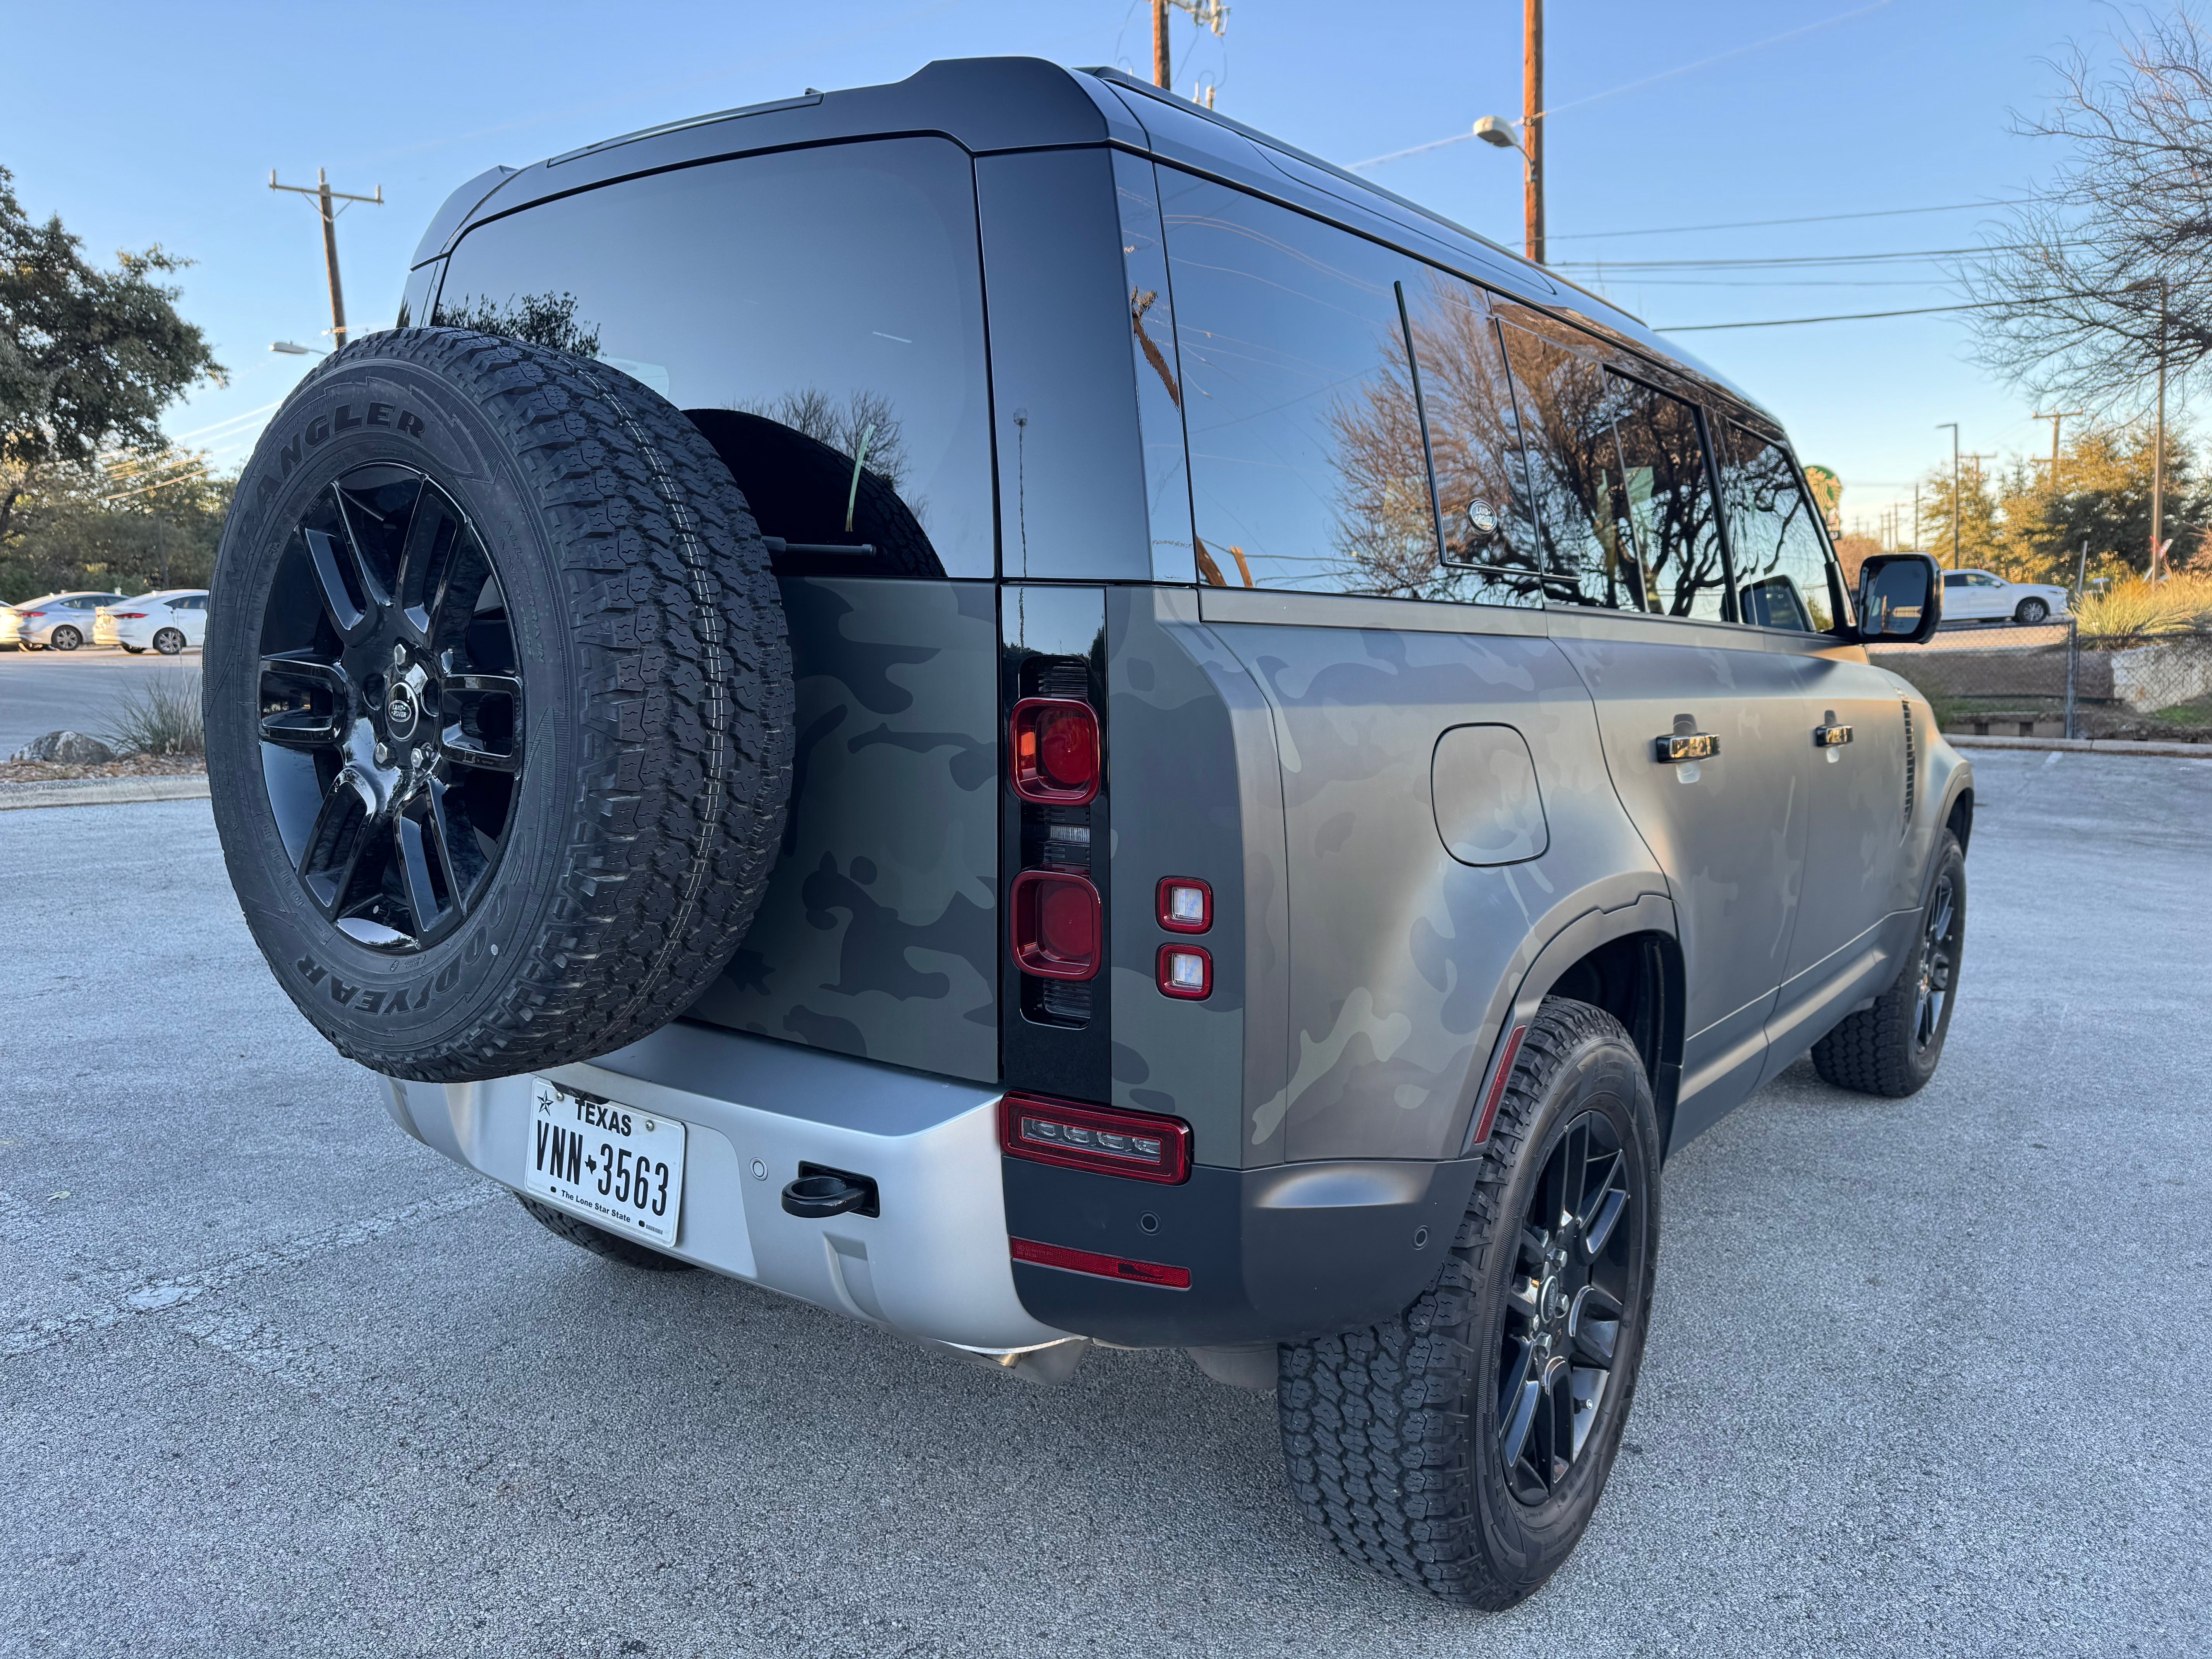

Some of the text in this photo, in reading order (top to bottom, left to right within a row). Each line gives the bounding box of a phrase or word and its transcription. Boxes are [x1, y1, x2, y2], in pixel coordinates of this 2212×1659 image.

[221, 402, 426, 607] WRANGLER
[296, 831, 526, 1015] GOODYEAR
[575, 1099, 632, 1137] TEXAS
[537, 1120, 669, 1216] VNN 3563
[562, 1190, 631, 1223] The Lone Star State
